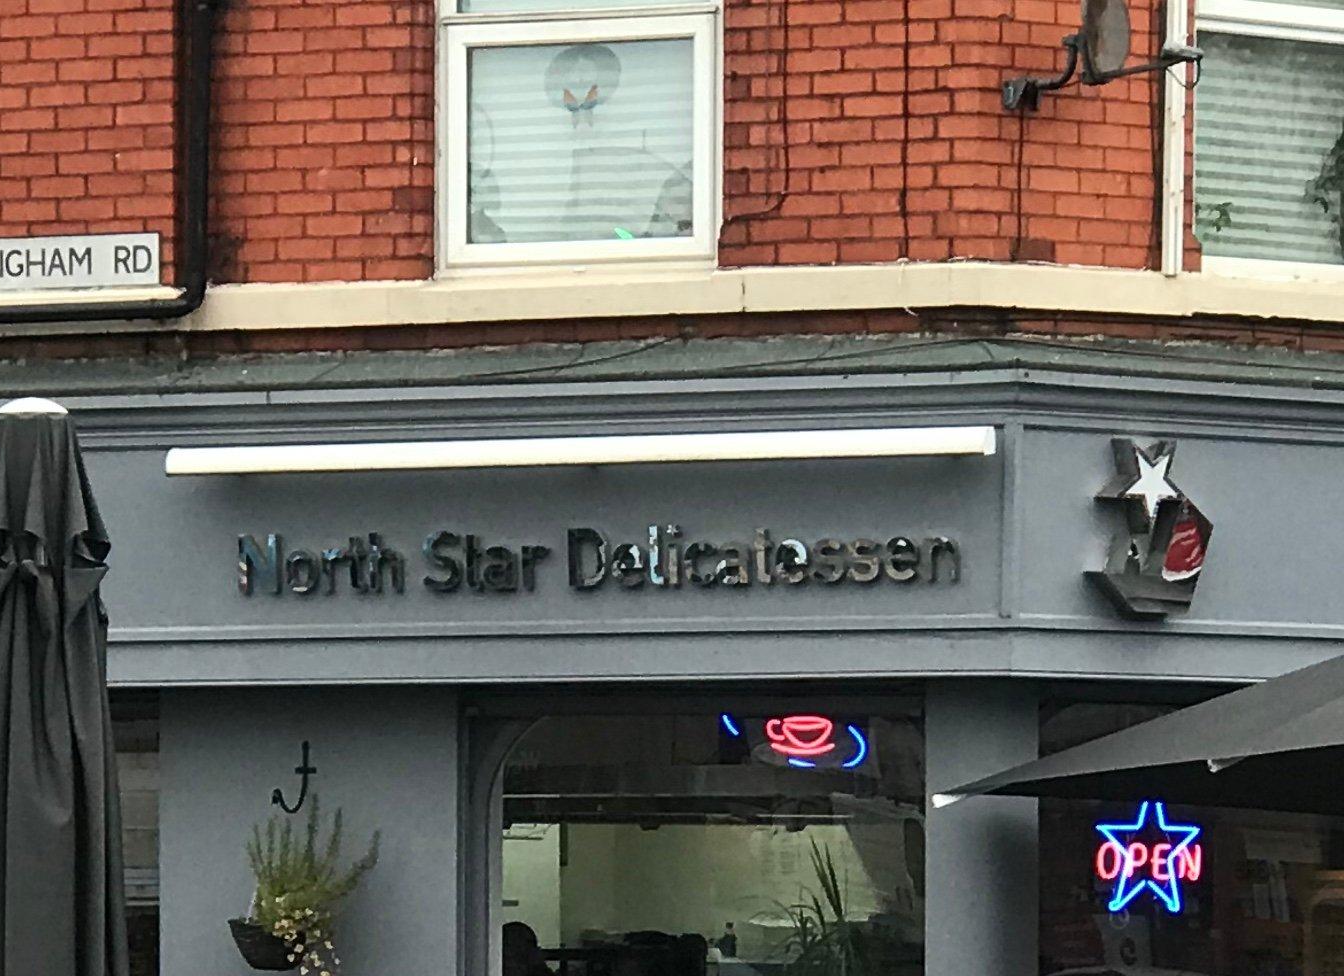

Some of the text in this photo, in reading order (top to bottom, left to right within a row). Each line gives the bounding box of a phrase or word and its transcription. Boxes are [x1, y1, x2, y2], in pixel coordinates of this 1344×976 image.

[113, 244, 153, 275] RD
[237, 524, 962, 596] North Star Delicatessen
[1096, 841, 1202, 882] OPEN
